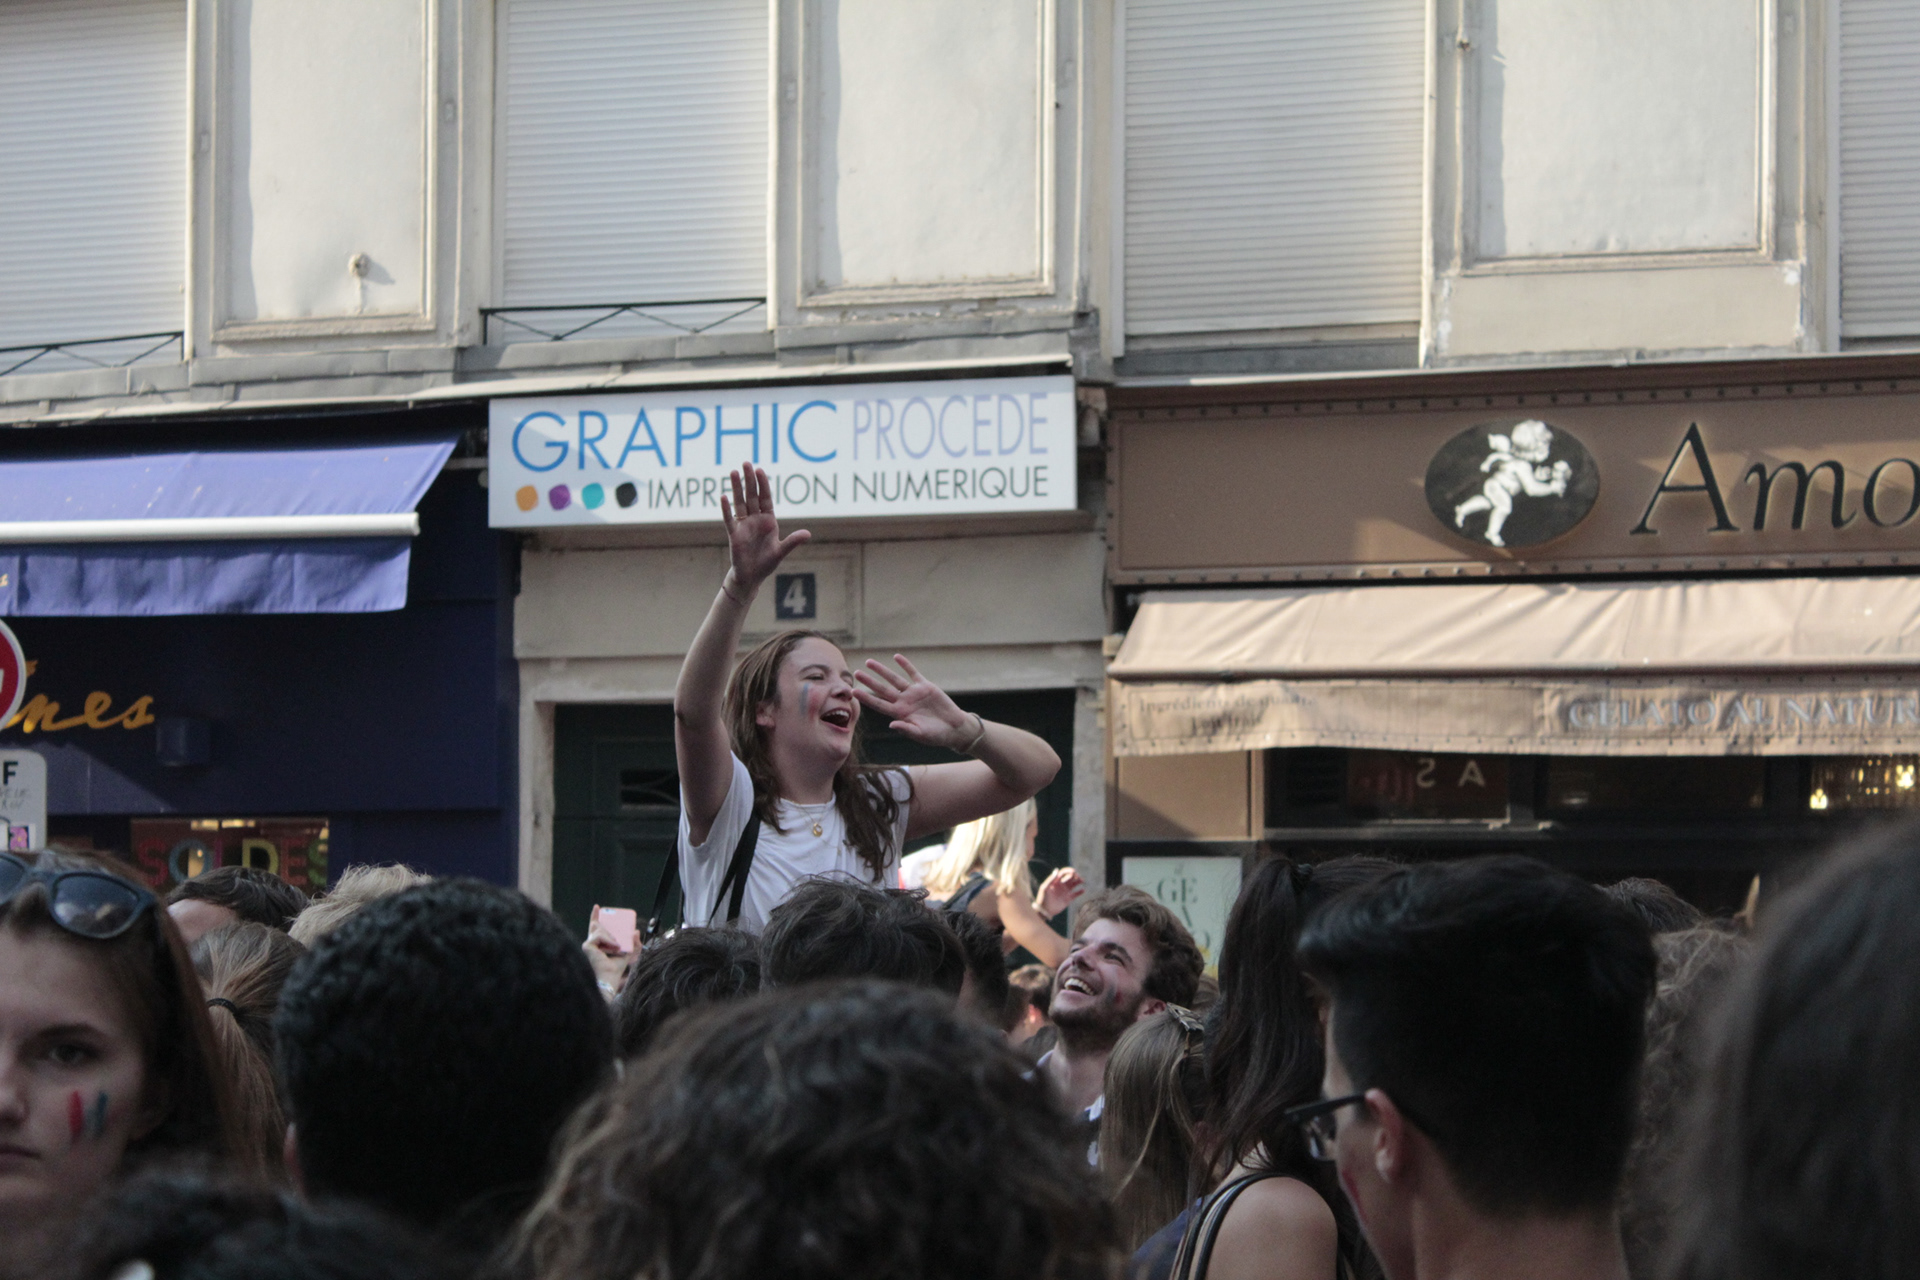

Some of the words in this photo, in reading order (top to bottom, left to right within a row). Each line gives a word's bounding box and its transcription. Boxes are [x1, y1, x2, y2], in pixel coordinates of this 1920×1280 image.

[511, 400, 838, 473] GRAPHIC
[852, 392, 1049, 461] PROCEDE
[648, 473, 838, 509] IMPREION
[853, 466, 1050, 502] NUMERIQUE
[1629, 421, 1920, 535] Amo
[781, 578, 807, 616] 4
[3, 661, 155, 733] nes
